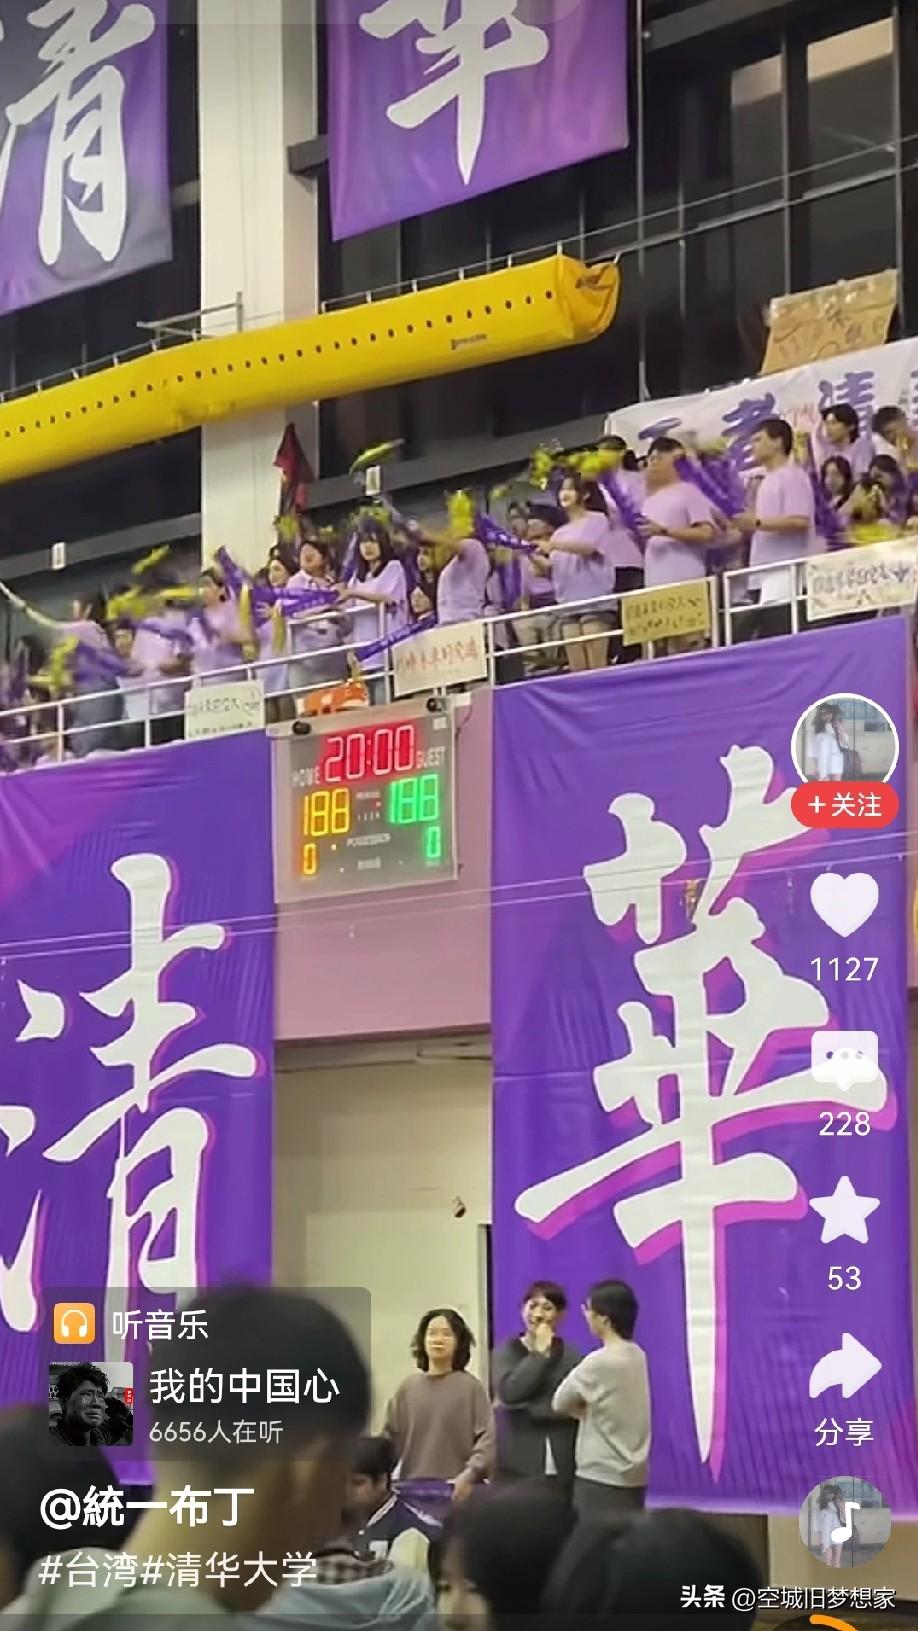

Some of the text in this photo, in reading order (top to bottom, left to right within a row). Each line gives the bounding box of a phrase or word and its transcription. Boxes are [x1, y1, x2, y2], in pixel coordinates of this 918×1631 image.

[324, 724, 415, 783] 20:00
[415, 746, 446, 769] GUEST
[292, 765, 321, 789] HOME
[303, 787, 350, 837] 188
[389, 773, 439, 824] 188
[303, 842, 317, 875] 0
[426, 825, 442, 858] 0
[514, 744, 889, 1464] 華
